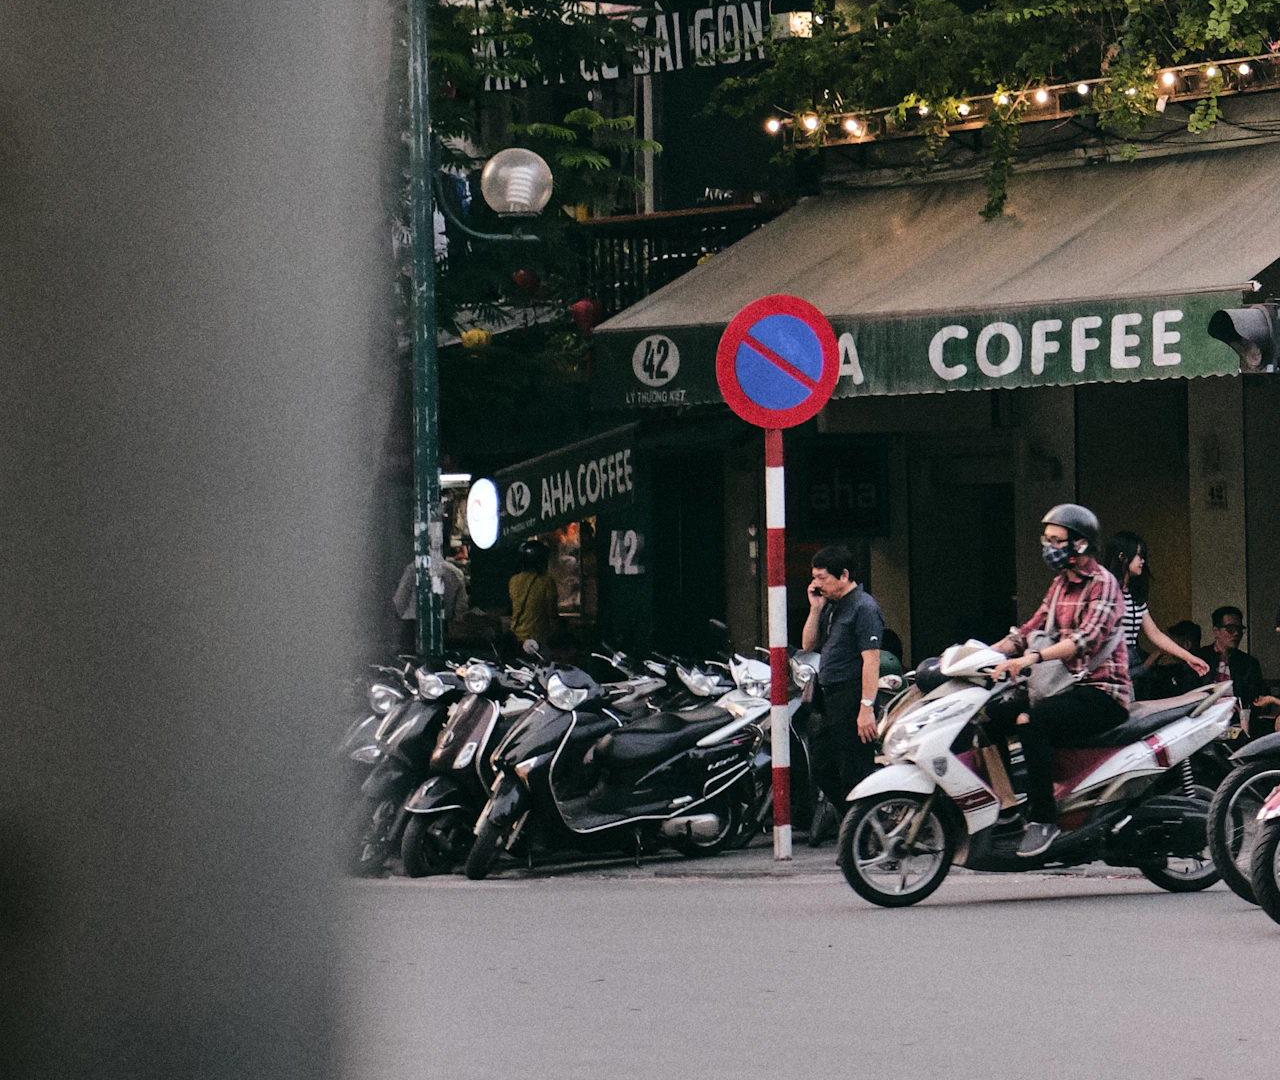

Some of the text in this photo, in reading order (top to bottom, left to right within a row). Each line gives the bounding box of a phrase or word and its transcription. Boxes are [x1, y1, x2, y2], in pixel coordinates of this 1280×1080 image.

[642, 338, 670, 381] 42
[927, 308, 1185, 382] COFFEE
[540, 468, 576, 521] AHA
[576, 448, 634, 507] COFFEE
[608, 529, 640, 576] 42
